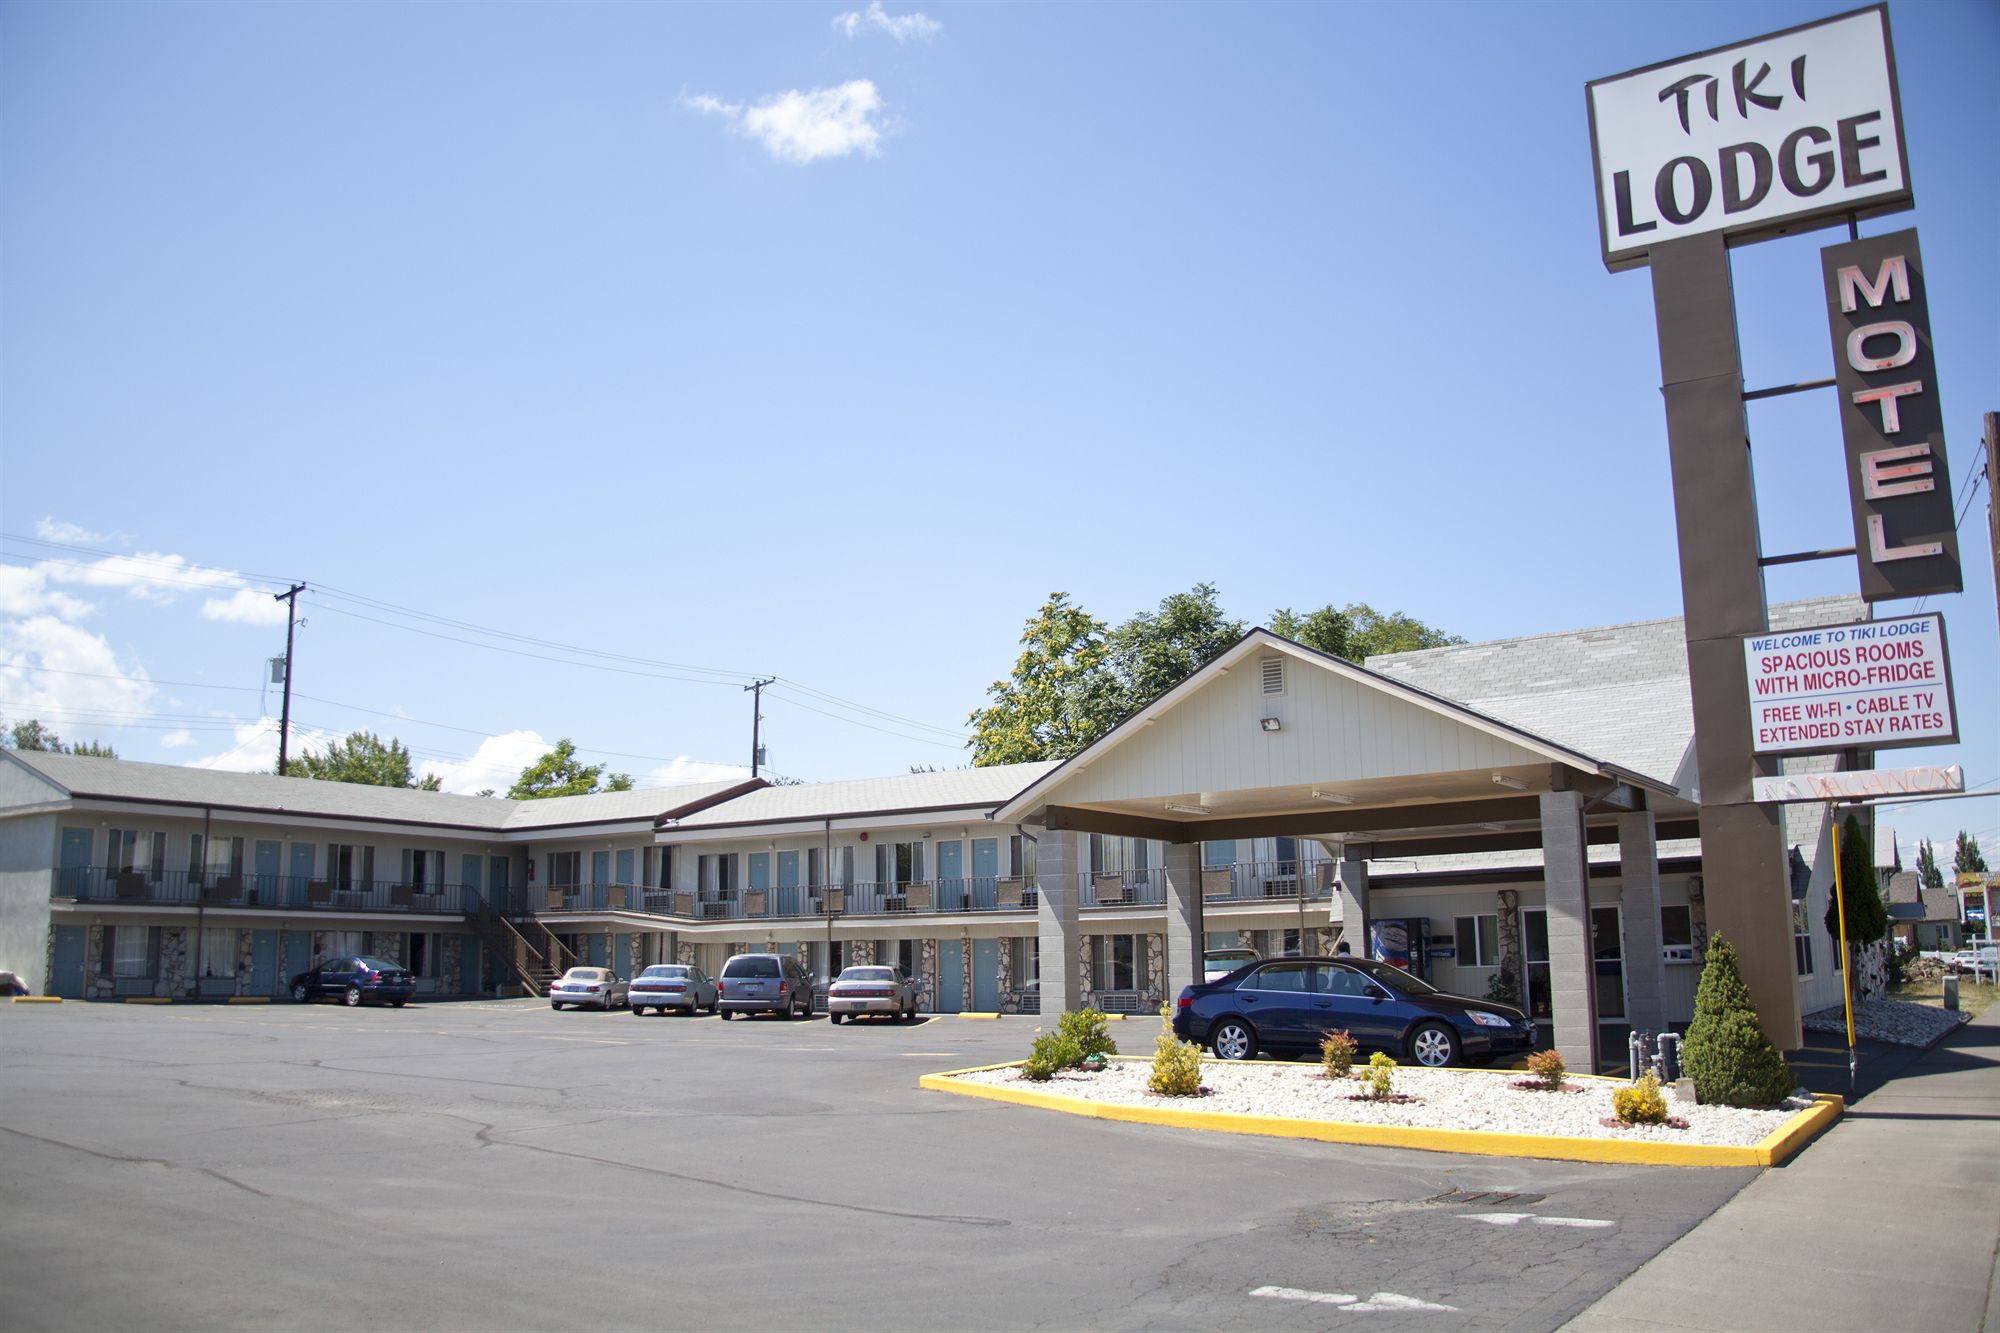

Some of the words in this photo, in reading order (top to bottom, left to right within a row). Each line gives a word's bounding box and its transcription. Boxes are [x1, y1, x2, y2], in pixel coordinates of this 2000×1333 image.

[1658, 54, 1807, 136] TIKI
[1613, 110, 1888, 237] LODGE
[1837, 255, 1943, 563] MOTEL
[1752, 633, 1822, 652] WELCOME
[1826, 630, 1845, 643] TO
[1849, 627, 1876, 640] TIKI
[1880, 621, 1930, 639] LODGE
[1761, 648, 1851, 674] SPACIOUS
[1855, 640, 1924, 664] ROOMS
[1755, 675, 1798, 695] WITH
[1803, 661, 1936, 691] MICRO-FRIDGE
[1763, 705, 1802, 723] FREE
[1805, 702, 1841, 720] WI-FI
[1856, 695, 1909, 714] CABLE
[1913, 692, 1934, 709] TV
[1760, 722, 1840, 743] EXTENDED
[1844, 718, 1884, 736] STAY
[1889, 713, 1944, 733] RATES
